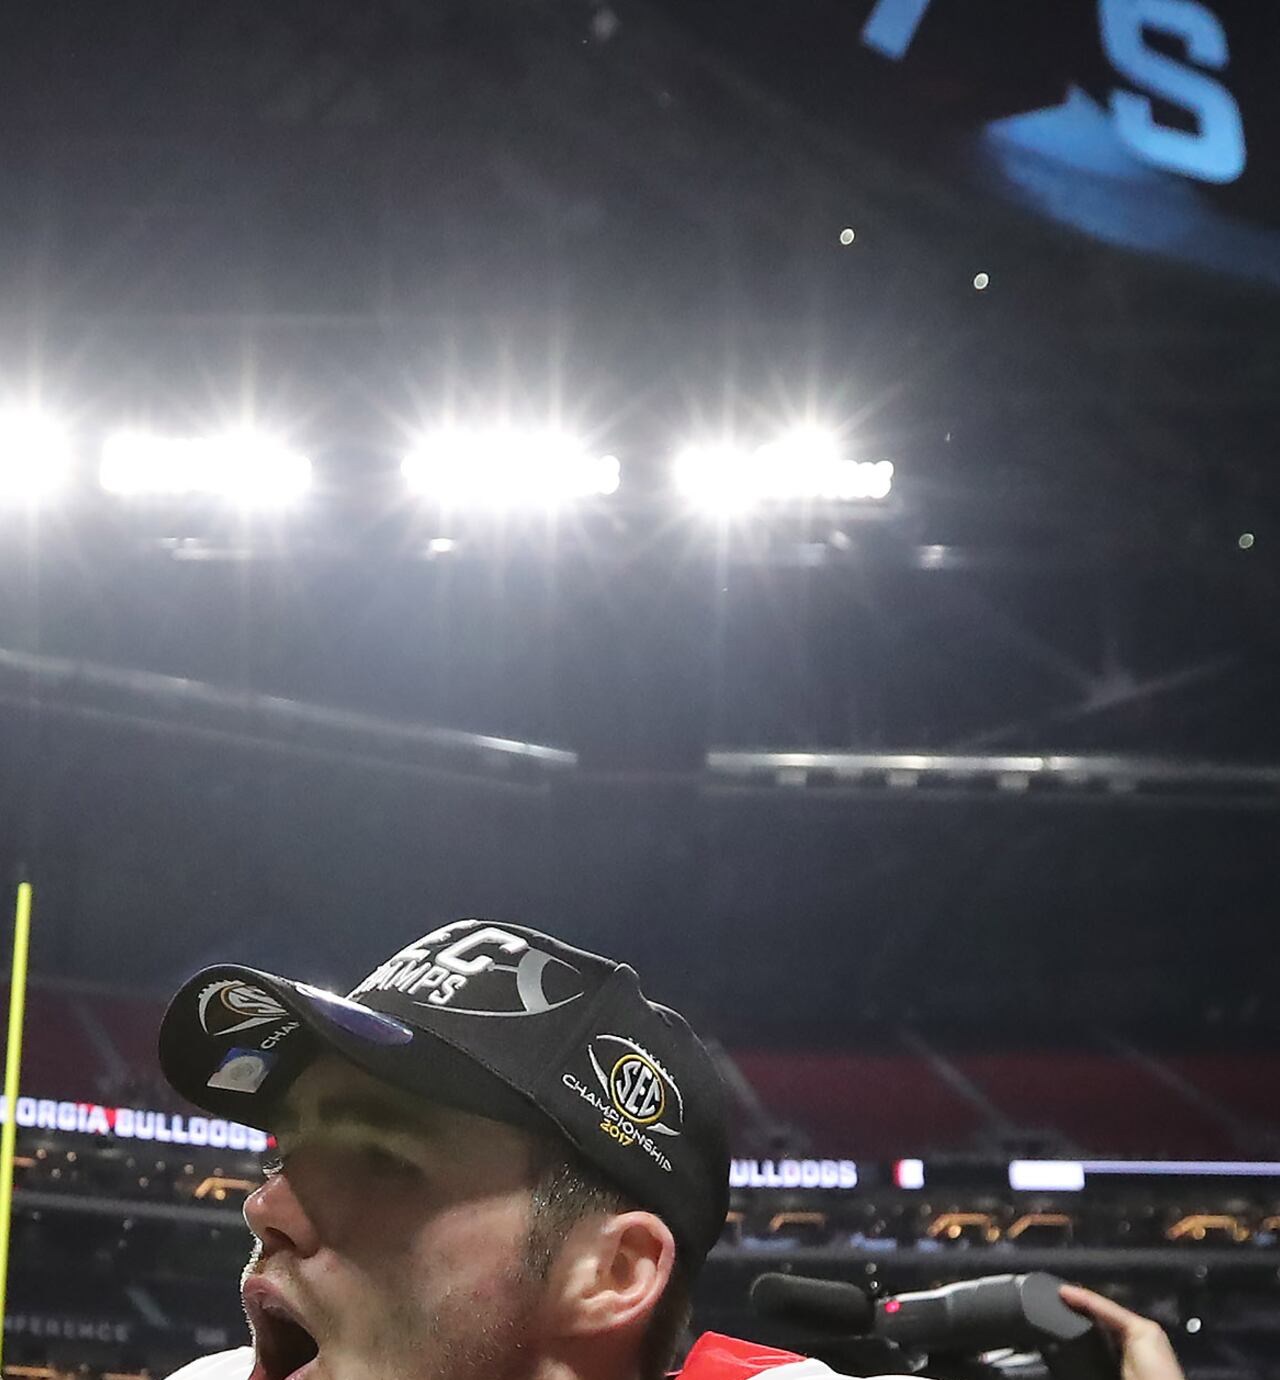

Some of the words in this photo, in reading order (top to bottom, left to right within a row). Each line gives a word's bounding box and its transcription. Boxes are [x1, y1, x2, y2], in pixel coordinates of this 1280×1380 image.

[616, 1060, 661, 1117] SEC
[562, 1074, 673, 1172] CHAMPIONSHIP
[600, 1118, 634, 1146] 2017
